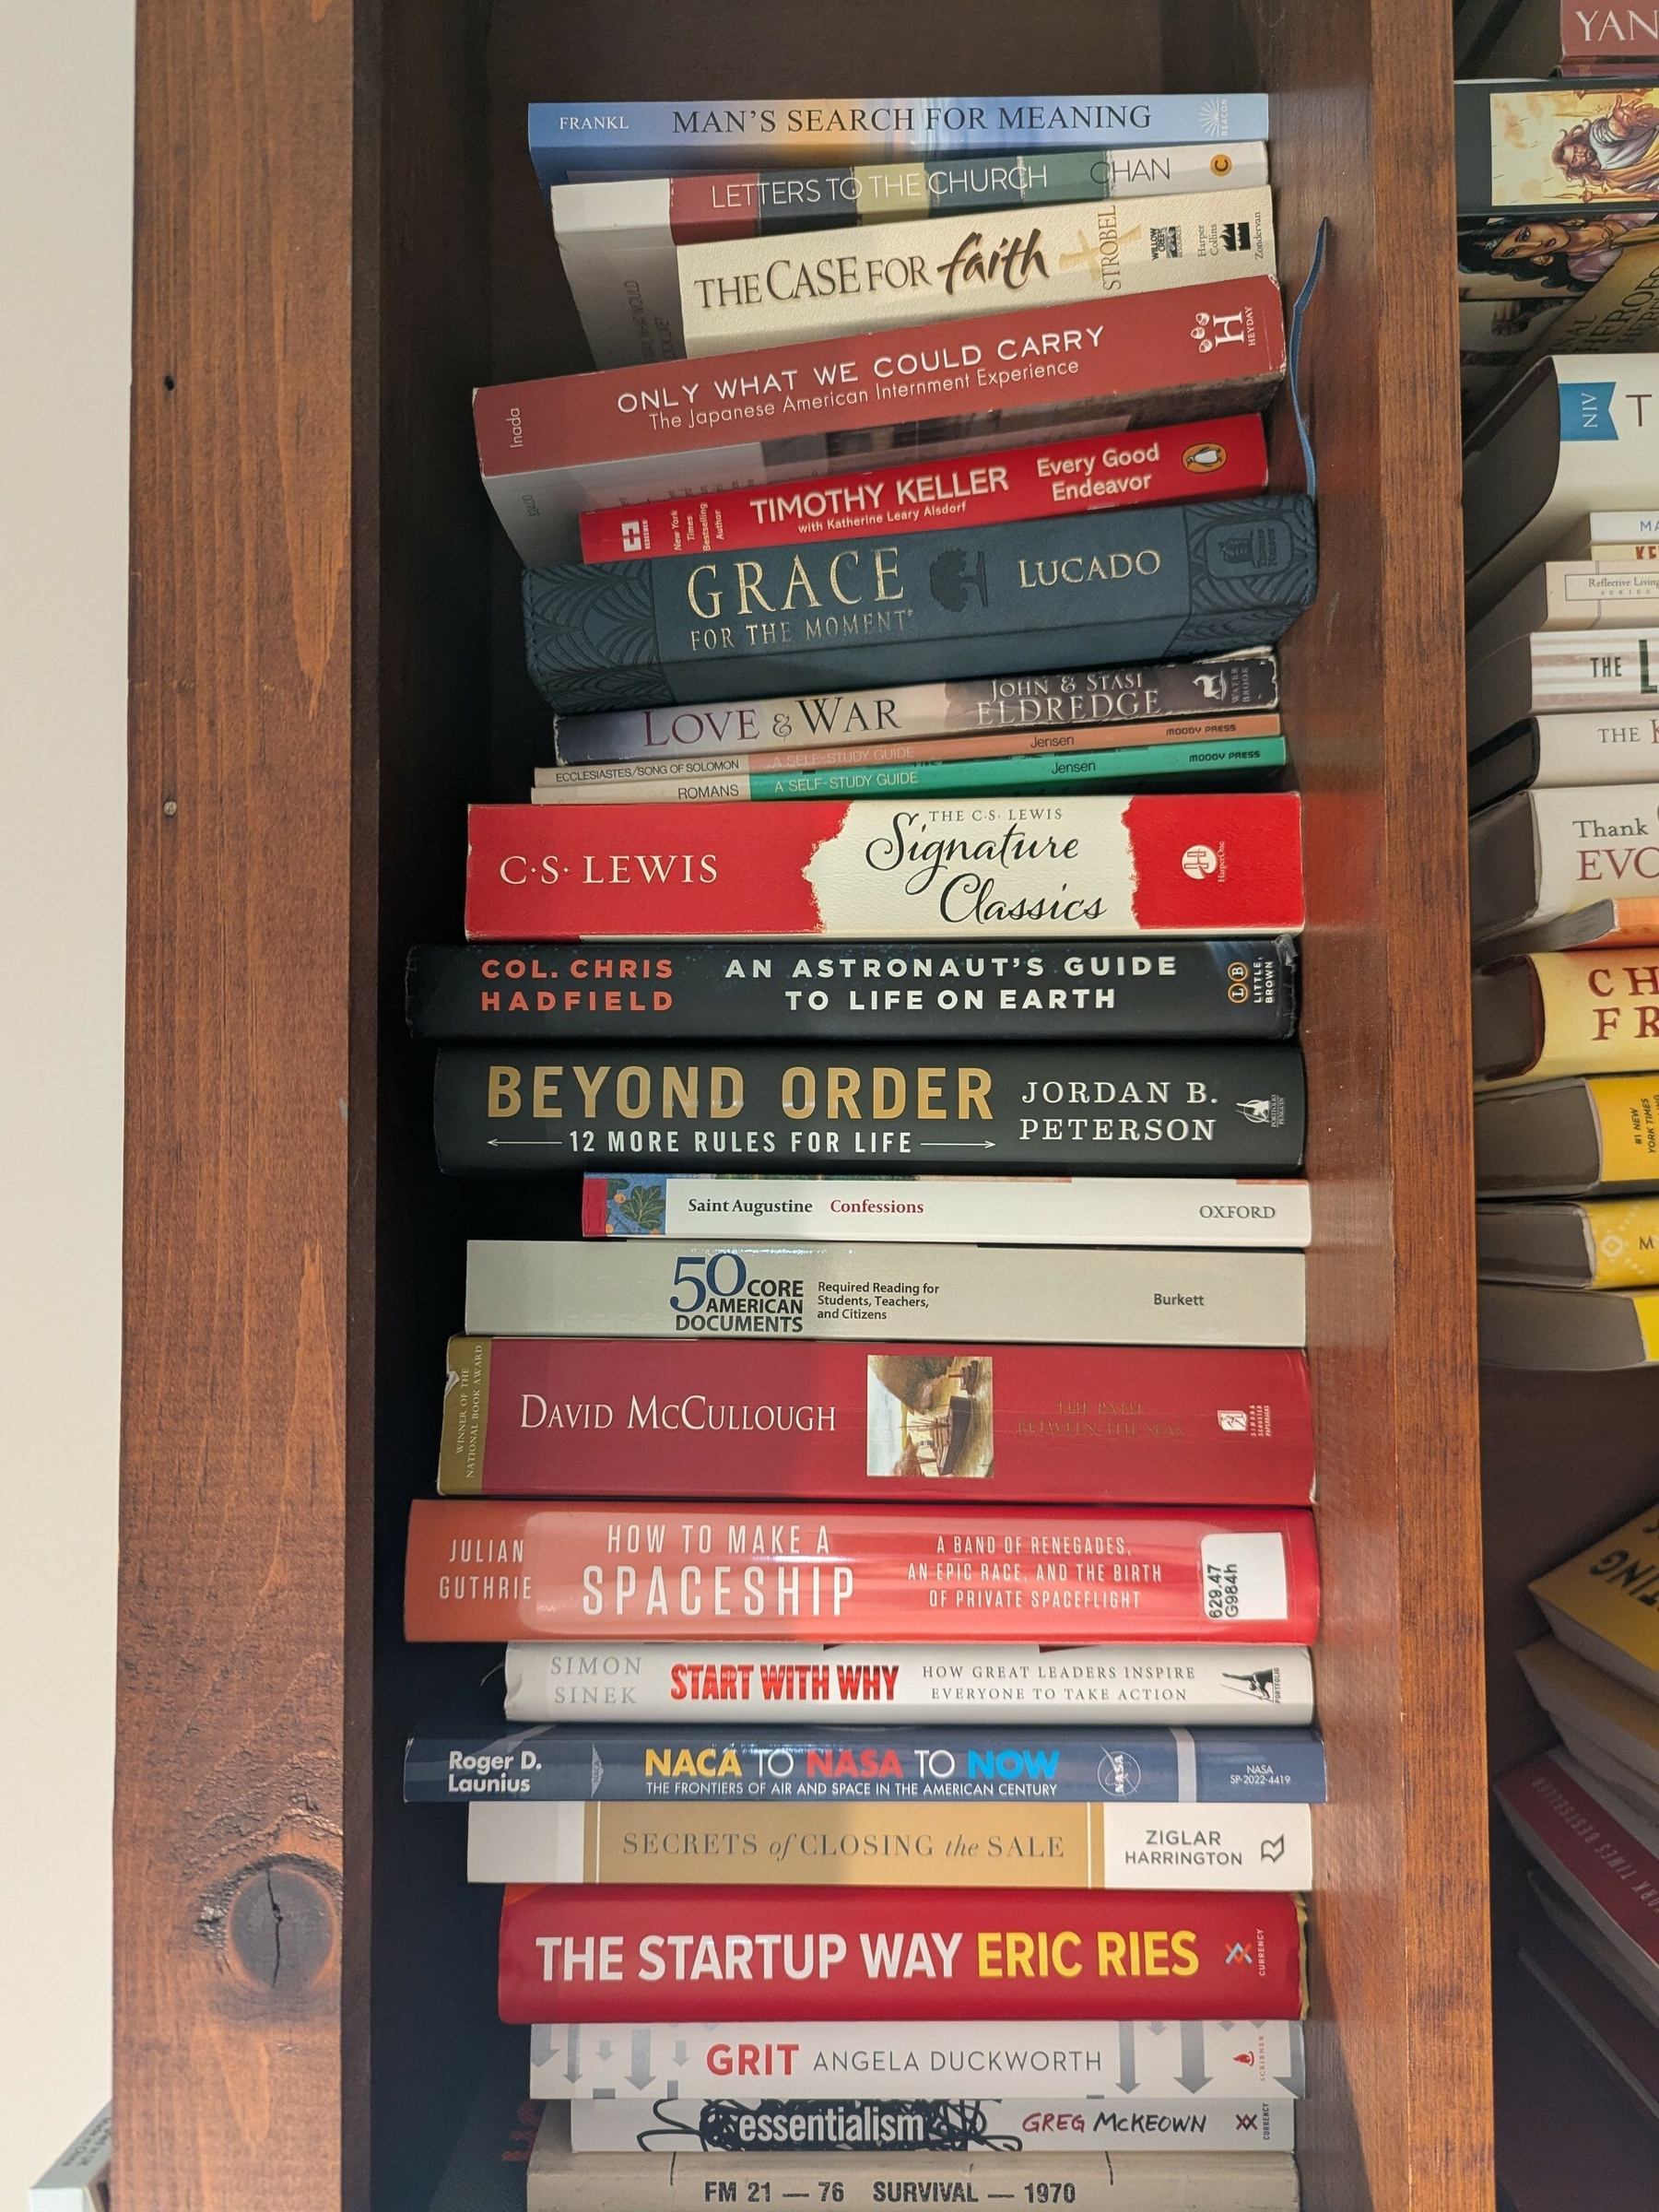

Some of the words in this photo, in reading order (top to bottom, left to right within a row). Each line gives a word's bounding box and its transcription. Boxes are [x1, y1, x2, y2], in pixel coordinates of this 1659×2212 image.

[559, 116, 629, 130] FRANKL
[788, 108, 915, 132] SEARCH
[925, 107, 986, 131] FOR
[998, 104, 1152, 130] MEANING
[1089, 159, 1171, 184] CHAN
[712, 179, 821, 207] LETTERS
[825, 176, 863, 201] TO
[870, 172, 920, 198] THE
[928, 166, 1047, 194] CHURCH
[1097, 205, 1122, 290] STROBEL
[1150, 228, 1159, 261] WILLOW
[1156, 228, 1165, 252] CREEK
[1198, 225, 1207, 257] Harper
[1210, 224, 1218, 255] Collins
[1253, 212, 1264, 260] Zondervan
[695, 275, 763, 309] THE
[766, 256, 861, 300] CASE
[865, 253, 932, 291] FOR
[936, 229, 1049, 294] faith
[1245, 307, 1255, 347] HEYDAY
[618, 383, 700, 414] ONLY
[713, 371, 798, 400] WHAT
[813, 362, 858, 386] WE
[874, 345, 982, 381] COULD
[997, 325, 1105, 359] CARRY
[649, 412, 682, 431] The
[688, 402, 776, 429] Japanese
[782, 389, 868, 413] American
[876, 373, 970, 401] Internment
[977, 359, 1080, 388] Experience
[1581, 392, 1598, 429] NIV
[509, 407, 524, 448] Inada
[1037, 455, 1097, 479] Every
[1102, 442, 1160, 468] Good
[749, 482, 886, 524] TIMOTHY
[896, 466, 1010, 505] KELLER
[1052, 474, 1152, 501] Endeavor
[670, 510, 678, 533] York
[687, 514, 696, 542] Times
[700, 501, 712, 552] Bestselling
[714, 509, 724, 541] Author
[674, 535, 682, 552] New
[687, 547, 904, 620] GRACE
[1018, 550, 1161, 590] LUCADO
[1588, 578, 1630, 587] Reflective
[690, 628, 735, 652] FOR
[745, 621, 794, 647] THE
[1590, 656, 1622, 678] THE
[1231, 668, 1240, 703] WATER
[1241, 667, 1250, 702] BROOK
[977, 689, 1163, 727] ELDREDGE
[1597, 727, 1641, 743] THE
[555, 764, 667, 783] ECCLESIASTES/SONG
[669, 763, 683, 774] OF
[685, 759, 739, 773] SOLOMON
[677, 784, 739, 800] ROMANS
[1572, 818, 1649, 838] Thank
[865, 811, 1079, 896] Signature
[1218, 841, 1228, 882] HarperOne
[939, 872, 1108, 924] Classics
[481, 959, 558, 979] COL.
[571, 959, 674, 979] CHRIS
[725, 959, 772, 978] AN
[1065, 957, 1177, 976] GUIDE
[1265, 961, 1274, 1003] BROWN
[481, 991, 674, 1011] HADFIELD
[785, 991, 830, 1010] TO
[850, 990, 924, 1010] LIFE
[936, 990, 984, 1010] ON
[1000, 988, 1116, 1009] EARTH
[488, 1065, 745, 1119] BEYOND
[782, 1066, 994, 1121] ORDER
[1021, 1081, 1171, 1103] JORDAN
[1186, 1082, 1218, 1103] B.
[1630, 1108, 1641, 1130] NEW
[1641, 1098, 1653, 1124] TIMES
[570, 1131, 595, 1152] 12
[608, 1131, 679, 1152] MORE
[695, 1131, 775, 1152] RULES
[791, 1131, 840, 1152] FOR
[853, 1132, 912, 1153] LIFE
[1019, 1119, 1218, 1141] PETERSON
[1634, 1135, 1641, 1144] #1
[1647, 1127, 1656, 1153] YORK
[688, 1198, 730, 1214] Saint
[732, 1198, 813, 1217] Augustine
[830, 1199, 924, 1215] Confessions
[1199, 1205, 1276, 1219] OXFORD
[670, 1253, 747, 1313] 50
[747, 1279, 804, 1298] CORE
[818, 1281, 869, 1297] Required
[873, 1282, 920, 1296] Reading
[923, 1283, 940, 1294] for
[705, 1299, 804, 1314] AMERICAN
[818, 1294, 872, 1309] Students,
[875, 1296, 929, 1309] Teachers,
[1153, 1293, 1204, 1306] Burkett
[676, 1315, 804, 1332] DOCUMENTS
[817, 1308, 839, 1319] and
[841, 1308, 888, 1320] Citizens
[474, 1345, 483, 1386] AWARD
[471, 1389, 480, 1420] BOOK
[456, 1404, 466, 1454] WINNER
[461, 1390, 468, 1402] OF
[465, 1424, 477, 1478] NATIONAL
[449, 1539, 524, 1563] JULIAN
[607, 1524, 666, 1553] HOW
[682, 1524, 712, 1553] TO
[728, 1525, 801, 1554] MAKE
[816, 1525, 830, 1554] A
[439, 1576, 533, 1600] GUTHRIE
[582, 1565, 855, 1616] SPACESHIP
[1208, 1564, 1223, 1619] 629.47
[1224, 1563, 1240, 1618] G984h
[551, 1656, 641, 1676] SIMON
[555, 1686, 637, 1704] SINEK
[449, 1751, 514, 1773] Roger
[520, 1751, 543, 1770] D.
[1246, 1765, 1274, 1774] NASA
[449, 1774, 531, 1794] Launius
[1230, 1774, 1291, 1785] SP-2022-4419
[1146, 1830, 1221, 1845] ZIGLAR
[1124, 1851, 1242, 1866] HARRINGTON
[535, 1936, 624, 1982] THE
[638, 1934, 848, 1982] STARTUP
[860, 1932, 963, 1978] WAY
[977, 1931, 1083, 1977] ERIC
[1098, 1930, 1199, 1977] RIES
[1258, 1927, 1266, 1976] CURRENCY
[706, 2042, 799, 2077] GRIT
[813, 2050, 919, 2072] ANGELA
[931, 2051, 1102, 2073] DUCKWORTH
[738, 2106, 924, 2142] essentialism
[1021, 2112, 1086, 2133] GREG
[1262, 2102, 1270, 2140] CURRENCY
